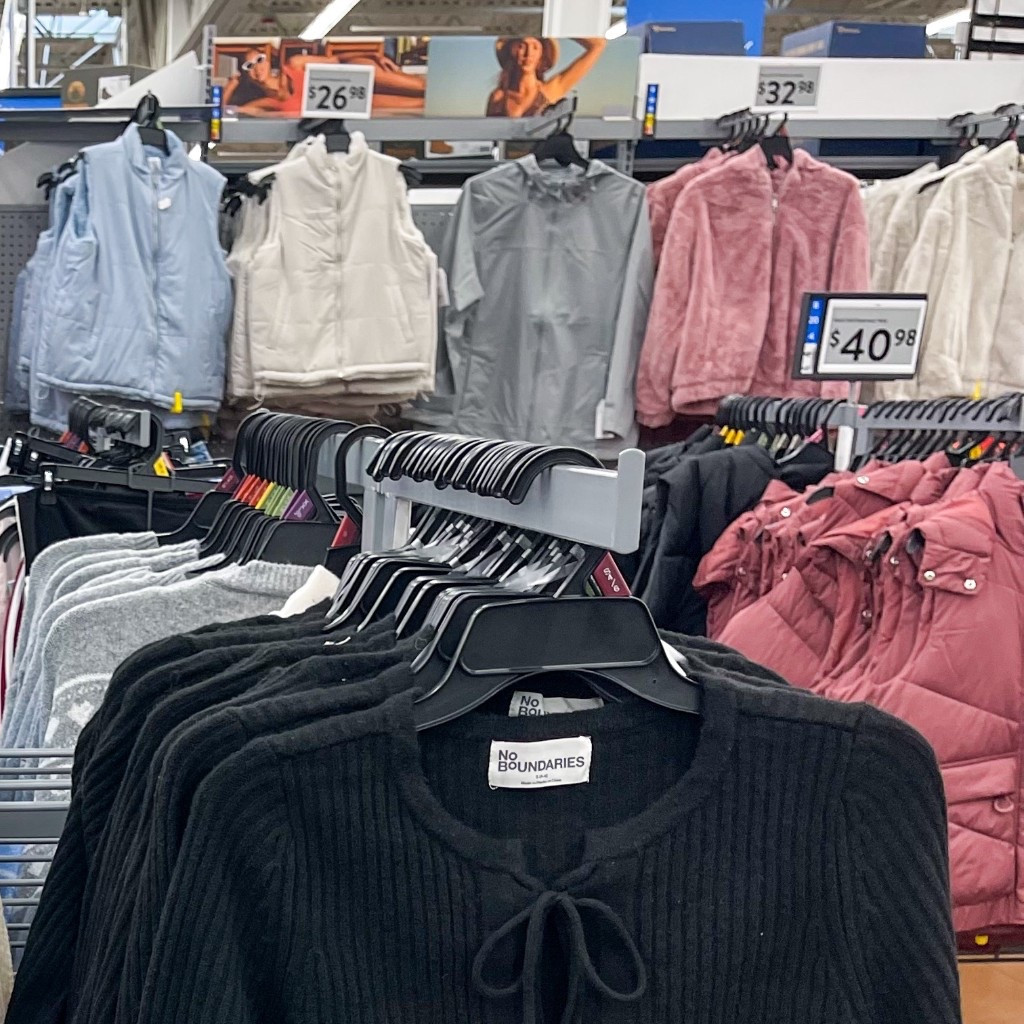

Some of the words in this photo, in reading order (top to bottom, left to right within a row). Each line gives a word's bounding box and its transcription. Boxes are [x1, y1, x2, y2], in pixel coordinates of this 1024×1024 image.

[829, 327, 917, 361] $4098
[520, 695, 539, 707] No
[498, 749, 518, 761] No
[497, 756, 585, 773] BOUNDARIES
